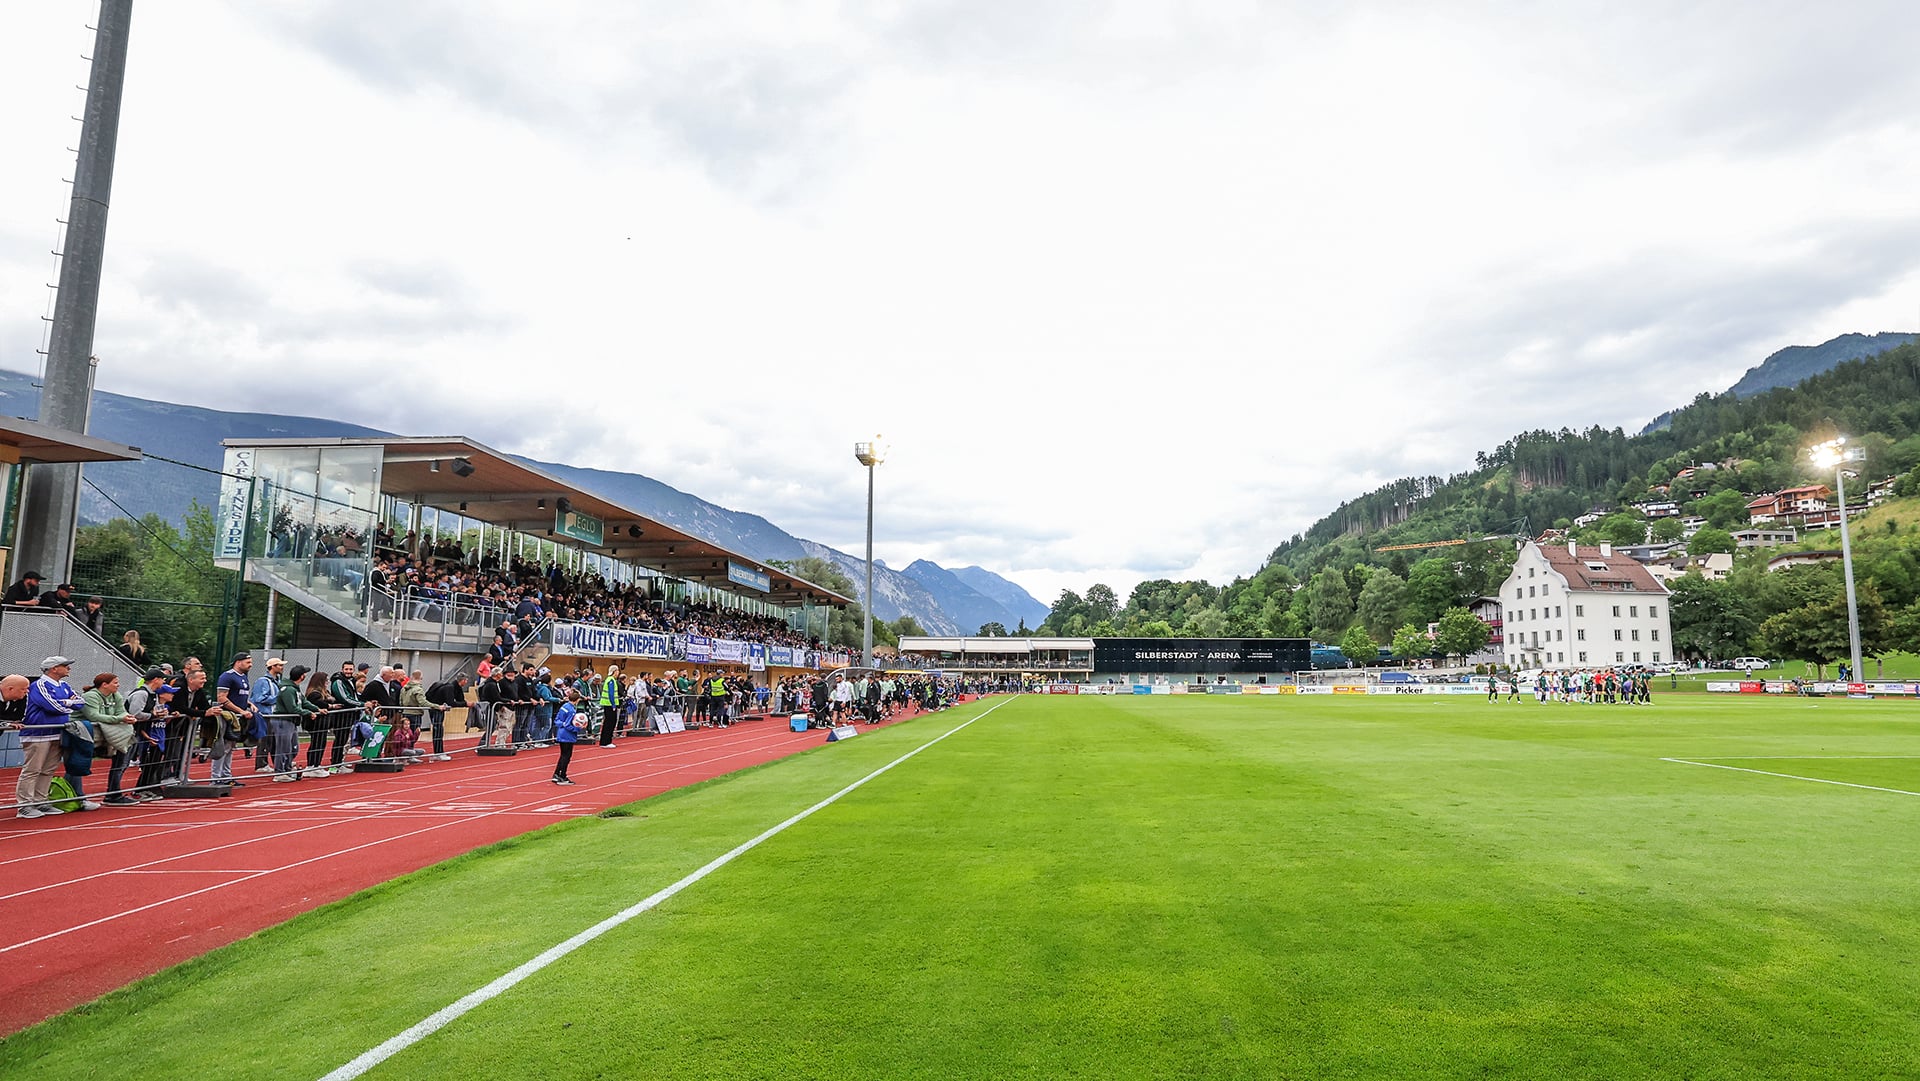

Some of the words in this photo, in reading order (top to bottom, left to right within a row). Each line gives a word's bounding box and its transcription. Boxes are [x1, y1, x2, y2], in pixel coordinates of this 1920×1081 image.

[228, 488, 245, 543] INNSIDE
[576, 516, 596, 534] EGLO
[617, 632, 668, 656] ENNEPETAL
[1135, 651, 1198, 659] SILBERSTADT
[1207, 651, 1241, 659] ARENA
[1395, 686, 1424, 695] Picker
